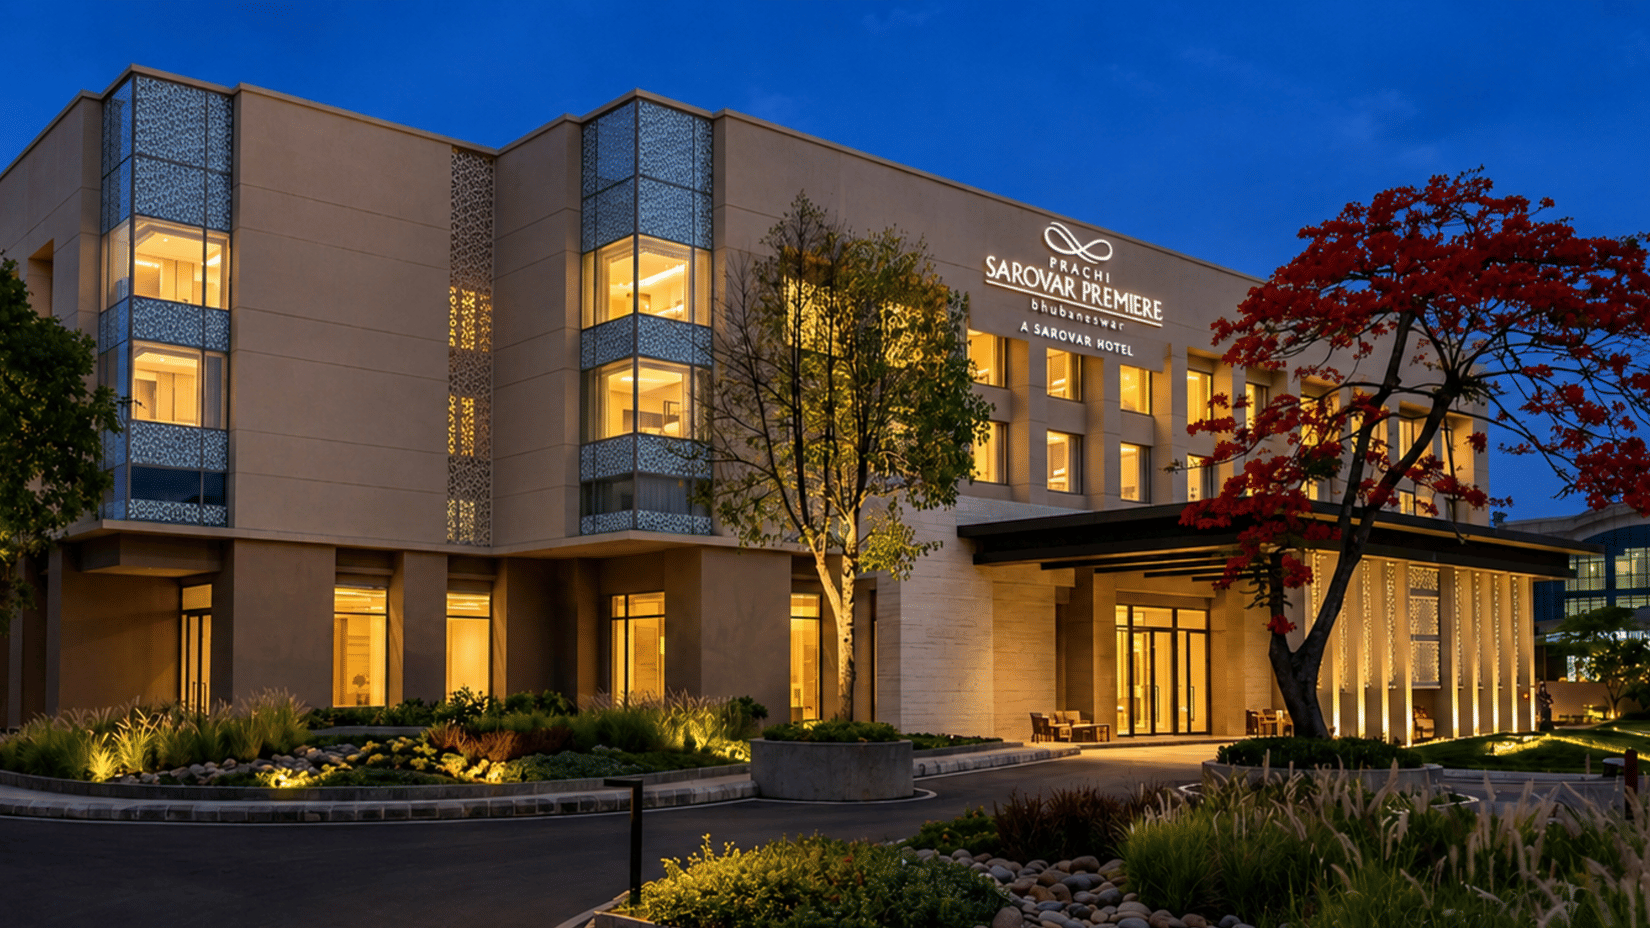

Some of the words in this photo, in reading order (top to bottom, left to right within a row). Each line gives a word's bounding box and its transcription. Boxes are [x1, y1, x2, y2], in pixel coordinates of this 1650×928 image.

[1050, 256, 1110, 284] PRACHI
[985, 255, 1077, 300] SAROVAR
[1082, 280, 1163, 321] PREMIERE
[1031, 298, 1125, 331] bhubaneswar
[1020, 321, 1029, 333] A
[1033, 323, 1092, 347] SAROVAR
[1097, 339, 1134, 357] HOTEL
